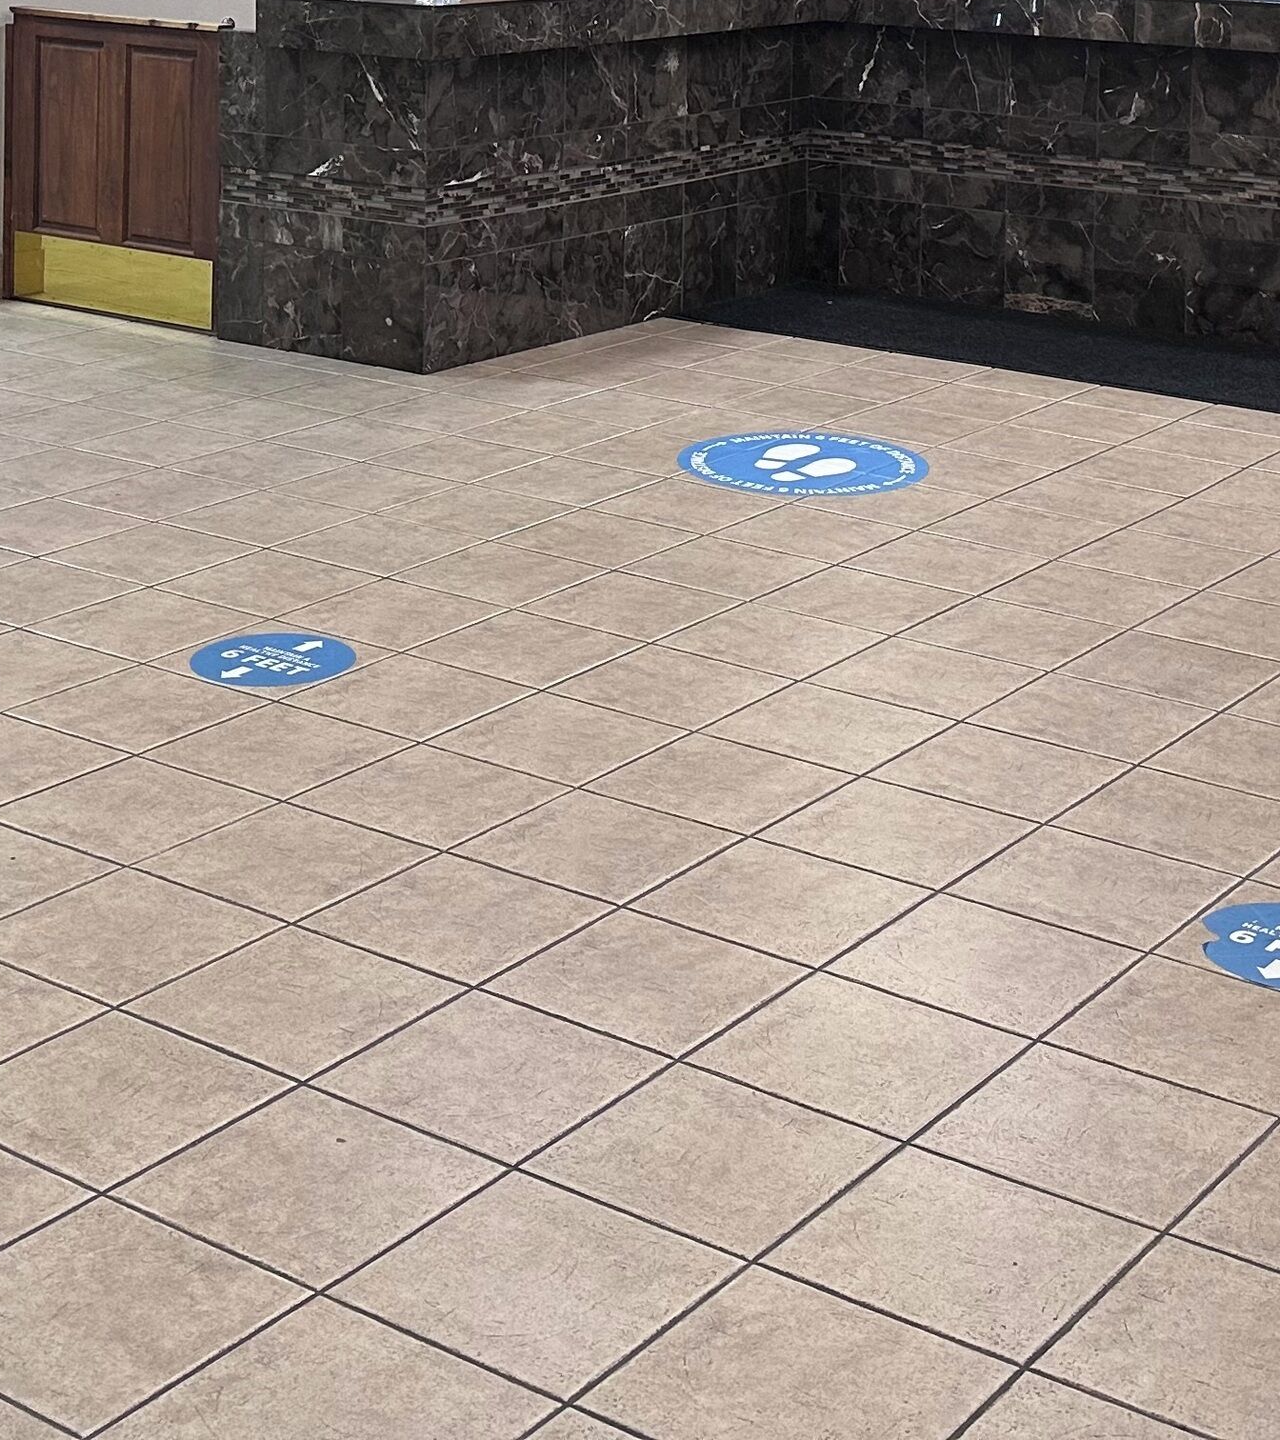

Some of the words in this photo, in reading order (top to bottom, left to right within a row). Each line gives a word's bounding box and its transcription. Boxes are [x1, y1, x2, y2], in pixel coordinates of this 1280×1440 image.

[729, 434, 810, 443] MAINTAIN
[221, 649, 245, 658] 6
[241, 654, 310, 675] FEET
[1229, 930, 1257, 944] 6
